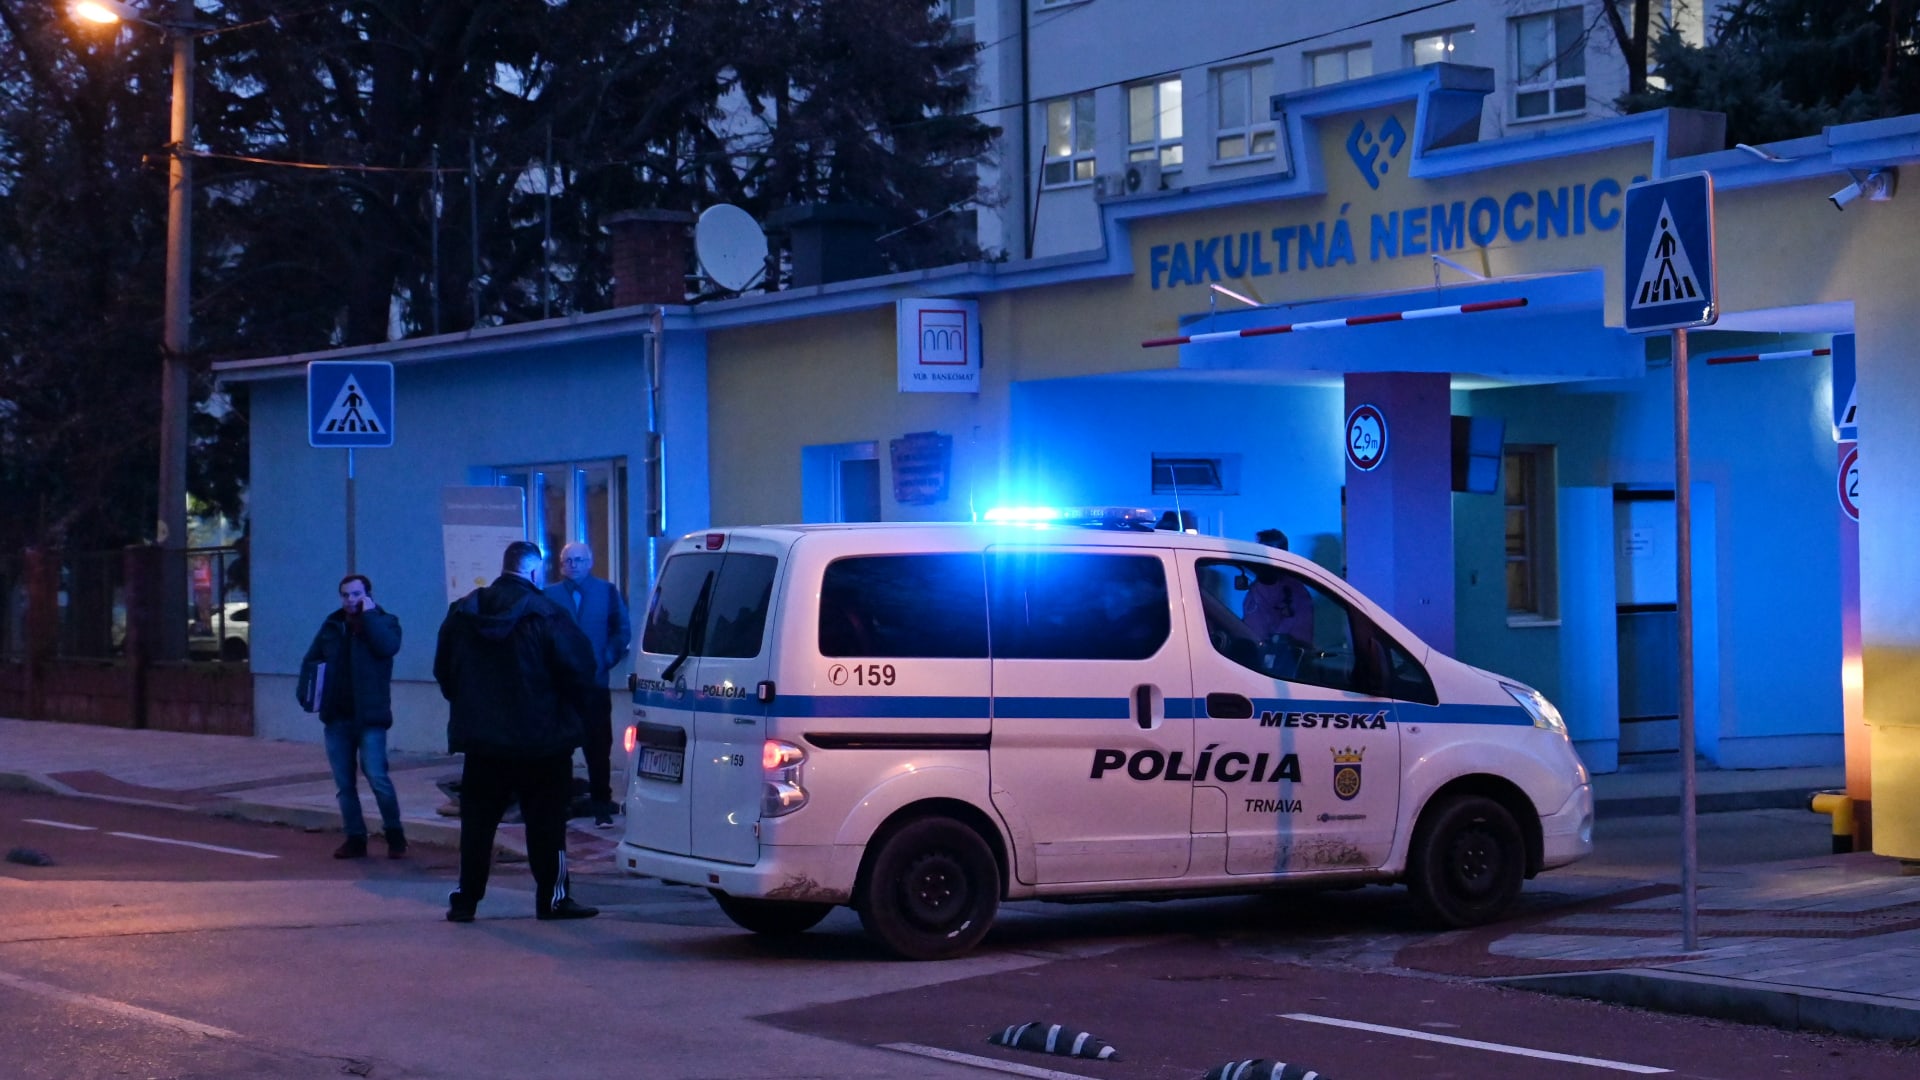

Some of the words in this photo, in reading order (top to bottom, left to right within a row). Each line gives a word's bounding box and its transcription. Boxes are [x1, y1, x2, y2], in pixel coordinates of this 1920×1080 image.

[1150, 203, 1357, 290] FAKULTNÁ
[1370, 175, 1648, 262] NEMOCNIC
[852, 664, 896, 687] 159
[1259, 709, 1388, 730] MESTSKÁ
[730, 754, 744, 767] 159
[1090, 743, 1302, 783] POLÍCIA
[1245, 799, 1302, 813] TRNAVA
